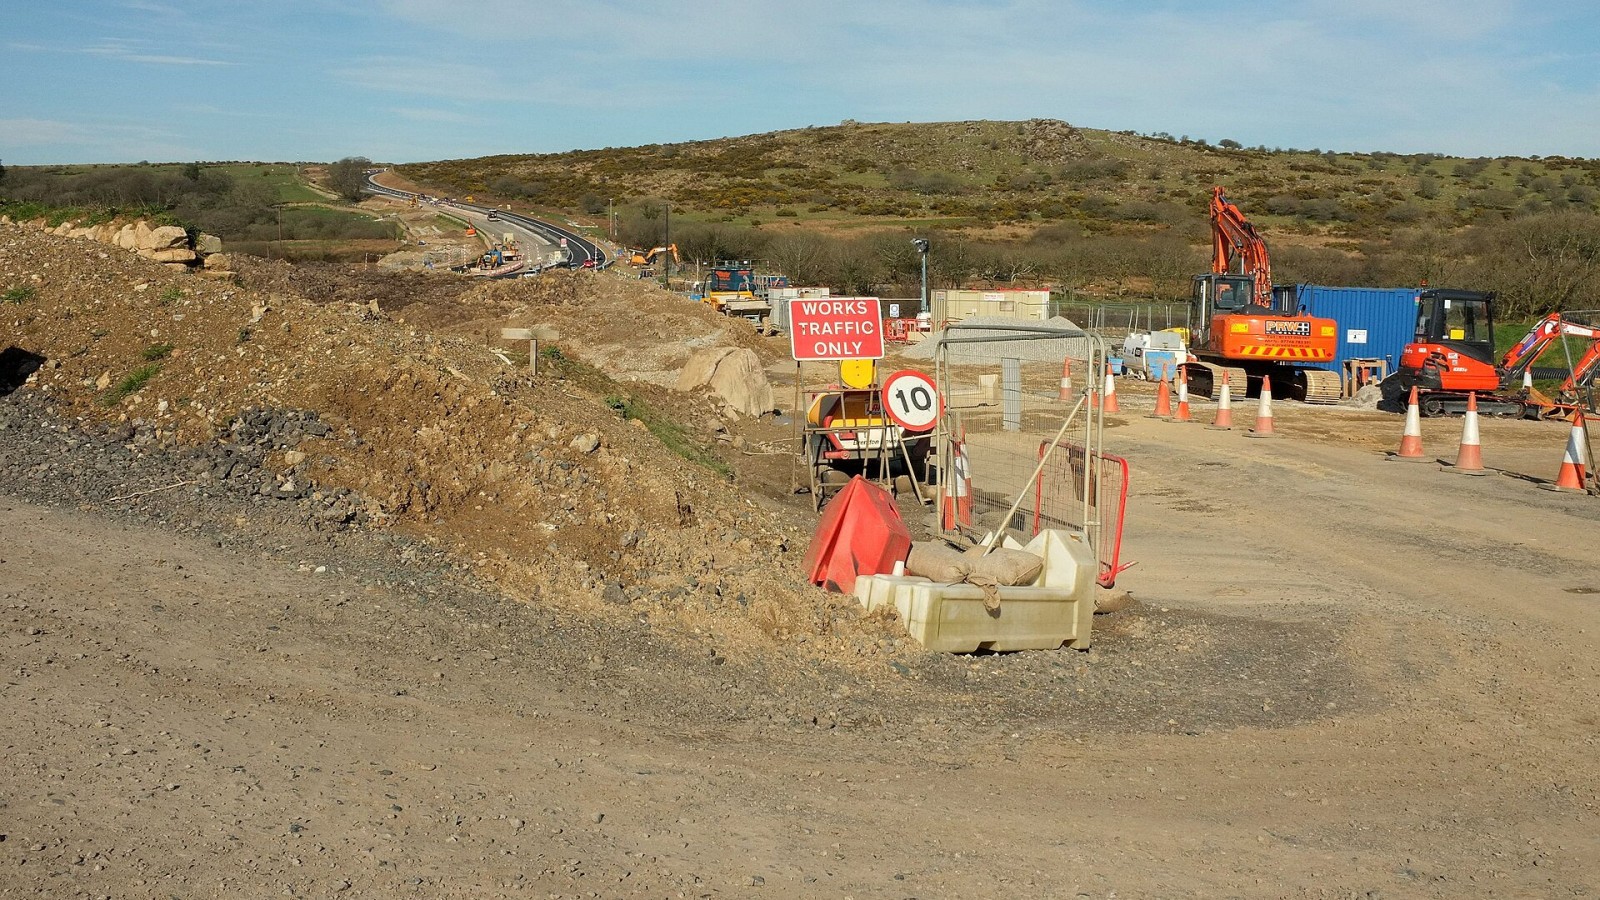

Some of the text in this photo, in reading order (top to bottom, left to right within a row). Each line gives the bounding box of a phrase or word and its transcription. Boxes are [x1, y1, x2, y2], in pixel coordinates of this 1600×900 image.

[801, 301, 868, 316] WORKS
[798, 321, 874, 336] TRAFFIC
[1265, 320, 1299, 331] PRW
[814, 341, 863, 356] ONLY
[895, 386, 932, 414] 10
